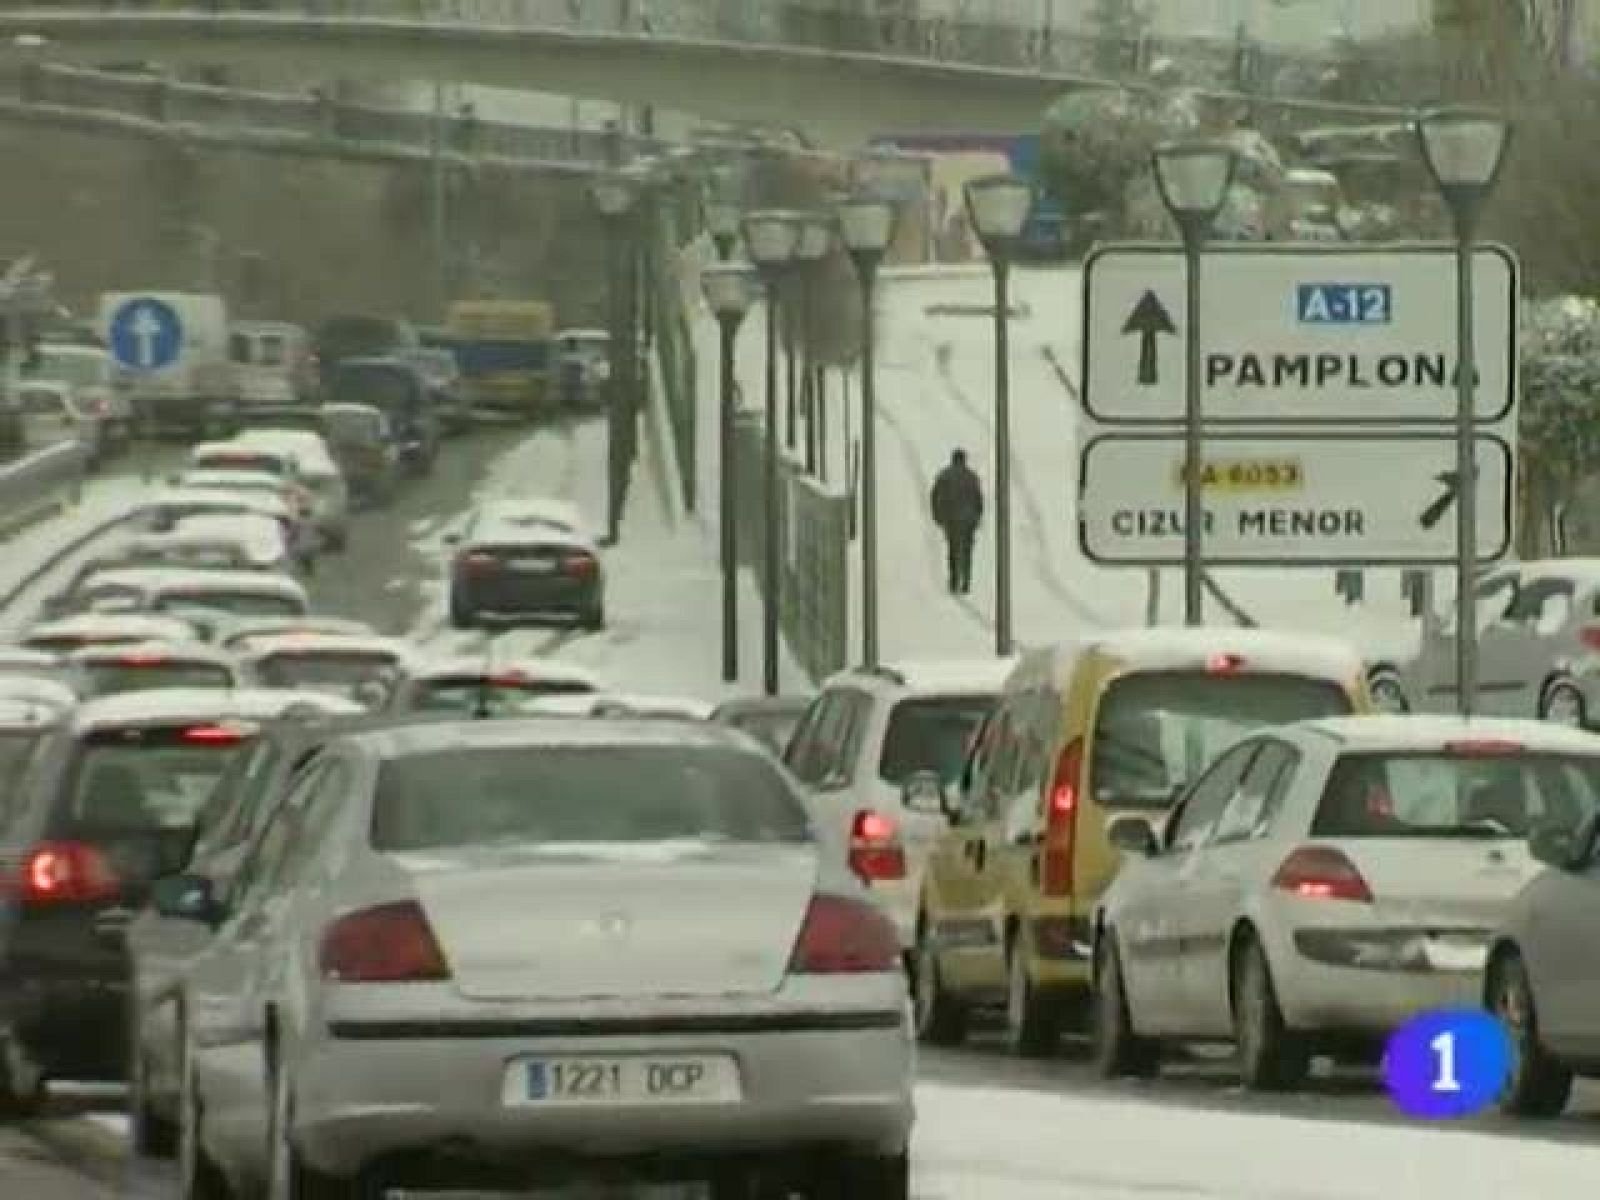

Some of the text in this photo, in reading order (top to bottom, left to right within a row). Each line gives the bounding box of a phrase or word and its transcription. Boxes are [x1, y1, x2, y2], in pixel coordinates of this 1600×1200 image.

[1303, 286, 1385, 321] A-12
[1238, 509, 1364, 536] MENOR
[552, 1063, 621, 1096] 1221
